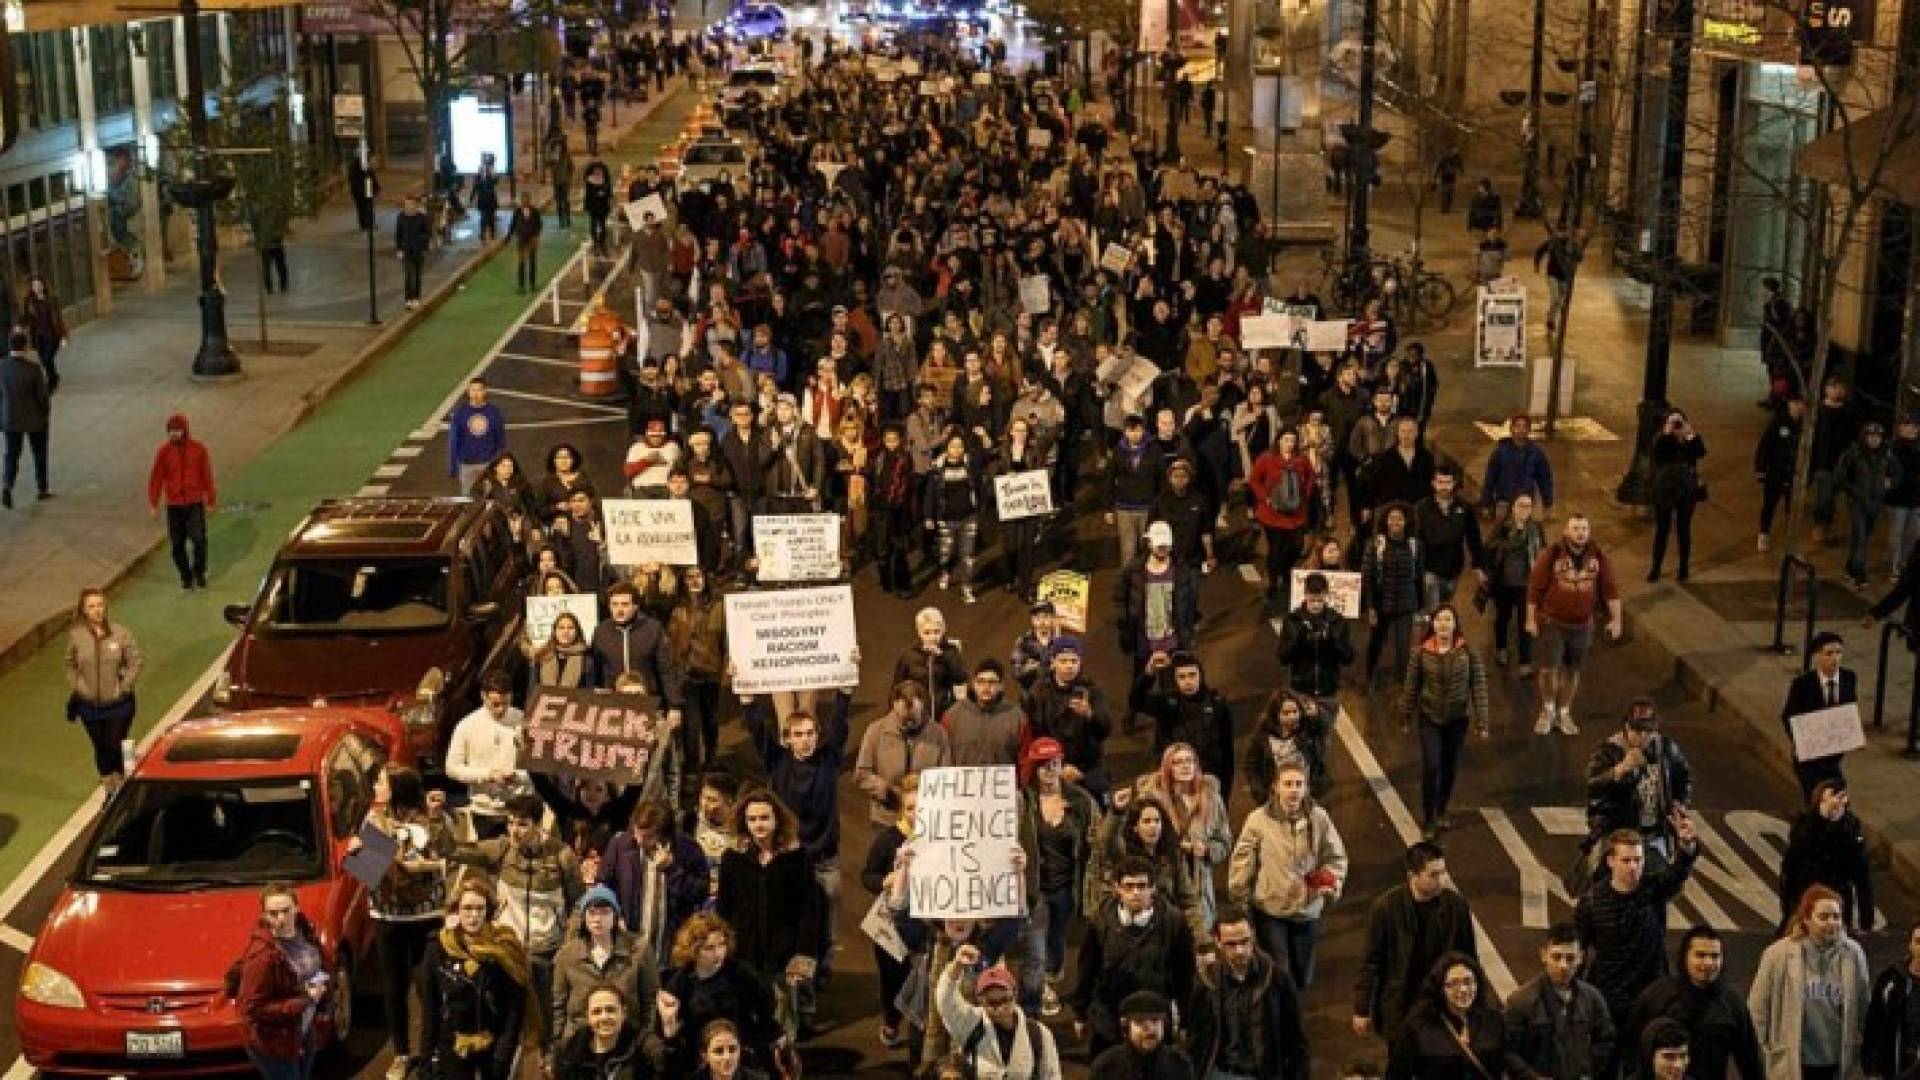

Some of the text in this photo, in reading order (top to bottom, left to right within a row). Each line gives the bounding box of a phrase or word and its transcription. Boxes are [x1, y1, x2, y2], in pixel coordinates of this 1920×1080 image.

[815, 593, 844, 605] ONLY
[756, 625, 827, 640] MISOGYNY
[767, 639, 819, 654] RACISM
[752, 653, 841, 669] XENOPHOBIA
[529, 694, 655, 742] FUCK
[528, 728, 650, 777] TRUMP
[922, 767, 1011, 800] WHITE
[915, 806, 1015, 843] SILENCE
[949, 842, 981, 874] IS
[912, 871, 1018, 914] VIOLENCE
